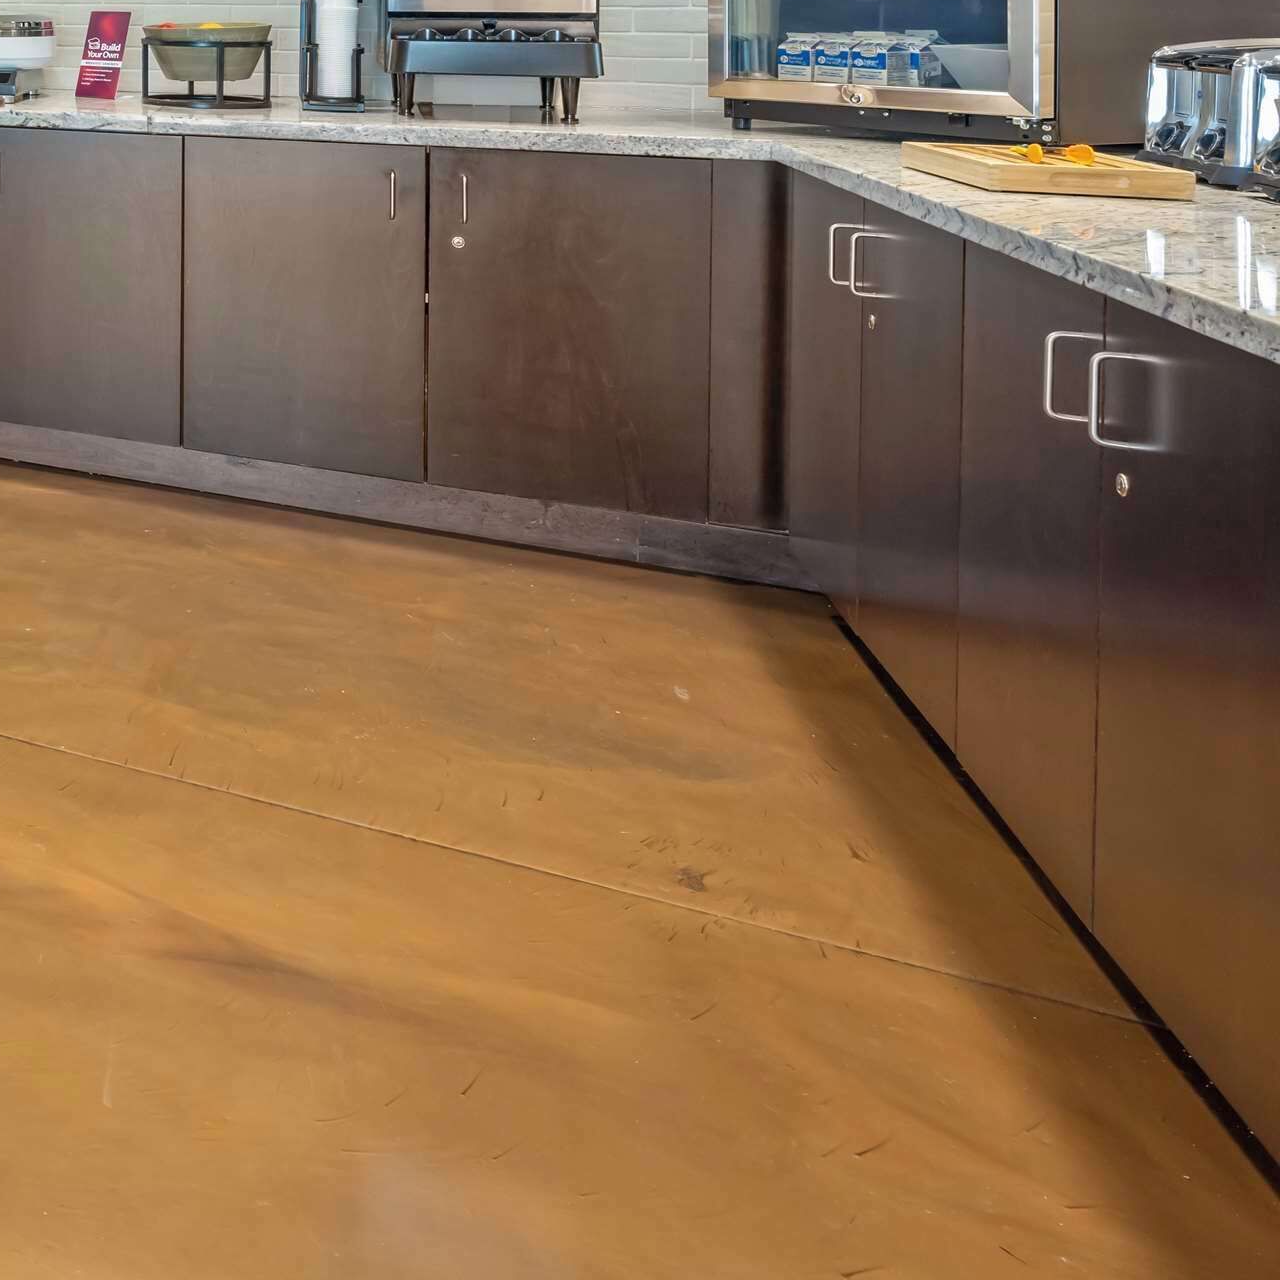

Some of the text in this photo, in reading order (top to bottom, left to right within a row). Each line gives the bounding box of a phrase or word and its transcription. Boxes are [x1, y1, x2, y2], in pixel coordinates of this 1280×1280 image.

[100, 43, 121, 52] Build
[87, 50, 120, 60] Your Own
